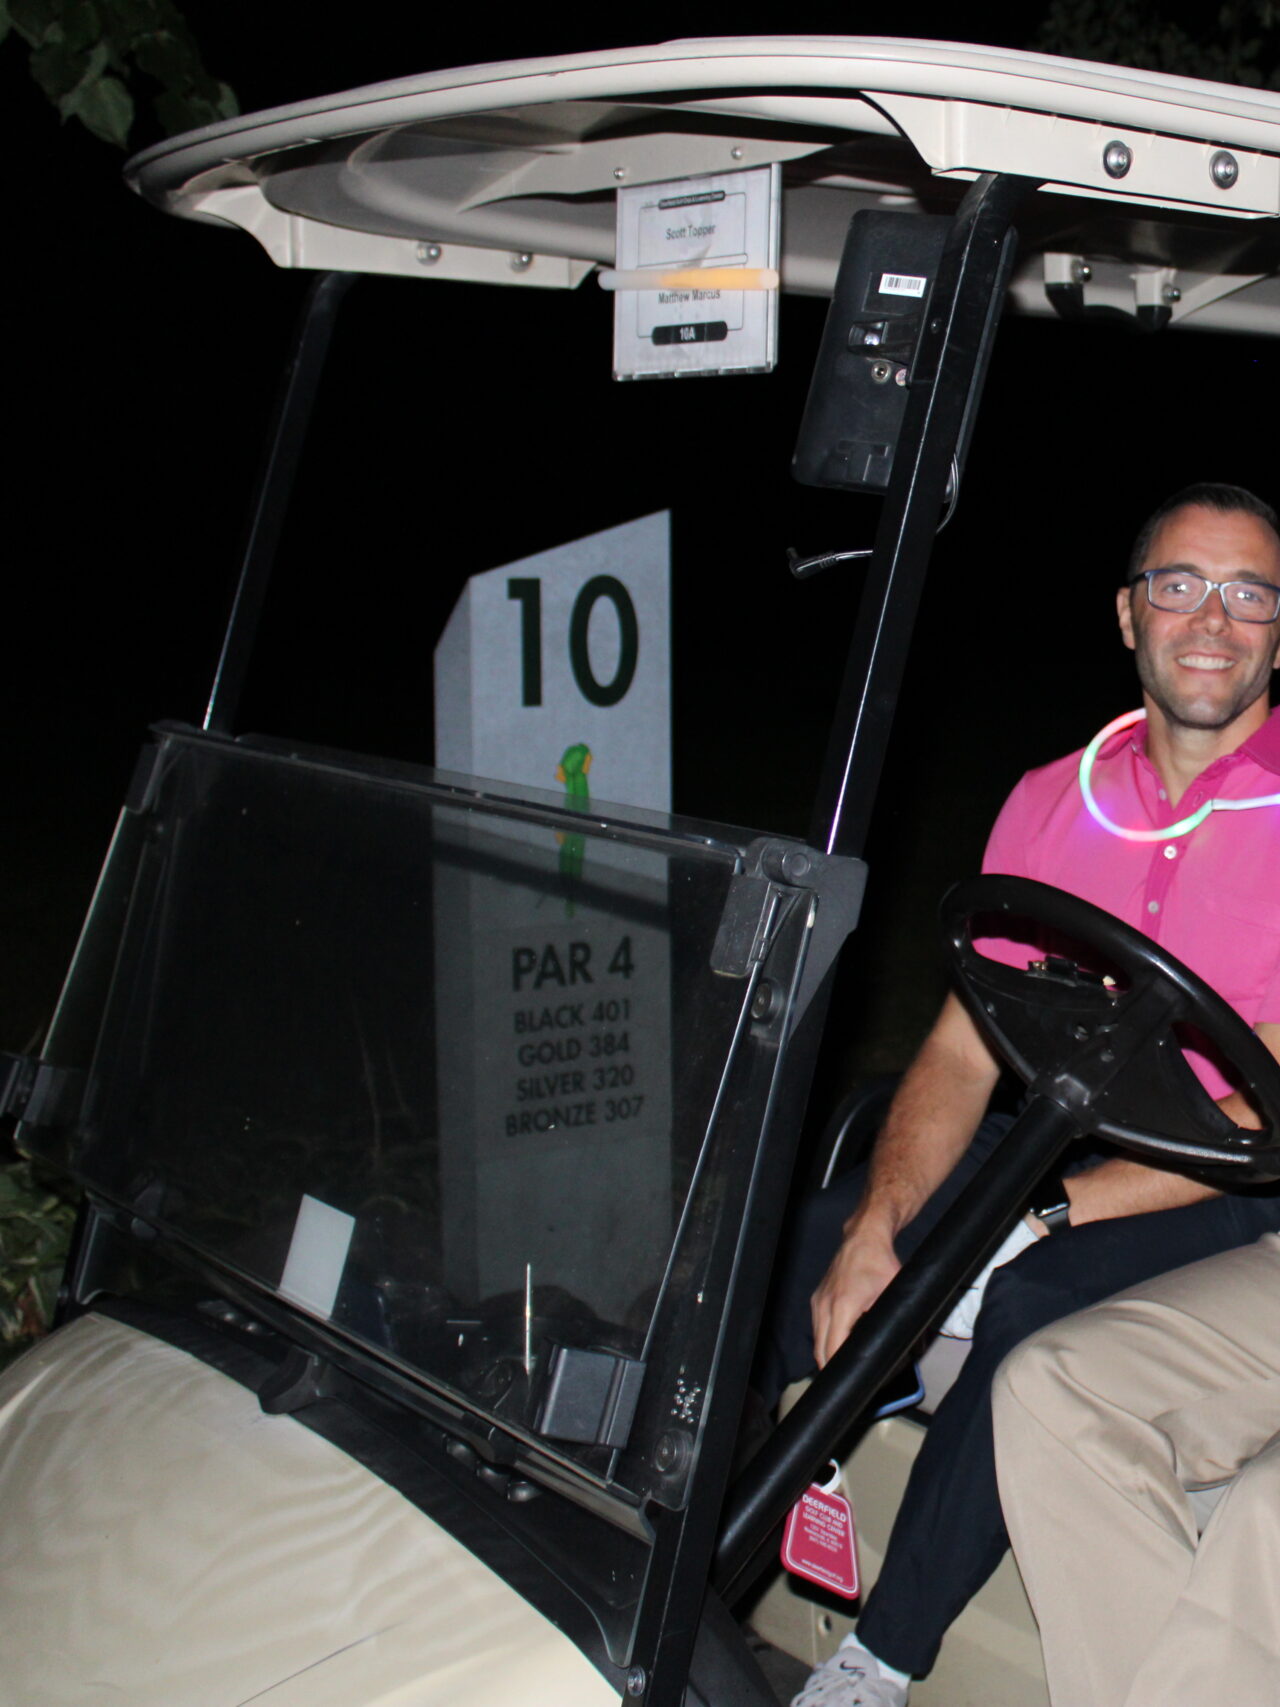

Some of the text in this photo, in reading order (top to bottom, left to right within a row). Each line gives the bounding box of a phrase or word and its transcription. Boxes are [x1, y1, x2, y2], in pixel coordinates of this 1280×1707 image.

[666, 224, 716, 240] Scott Topper
[658, 289, 721, 304] Matthew Marcus
[680, 326, 696, 340] 10A
[507, 573, 639, 708] 10
[512, 935, 634, 992] PAR 4
[514, 998, 631, 1034] BLACK 401
[517, 1032, 630, 1067] GOLD 384
[516, 1064, 635, 1101] SILVER 320
[505, 1095, 645, 1137] BRONZE 307
[802, 1494, 847, 1522] DEERFIELD
